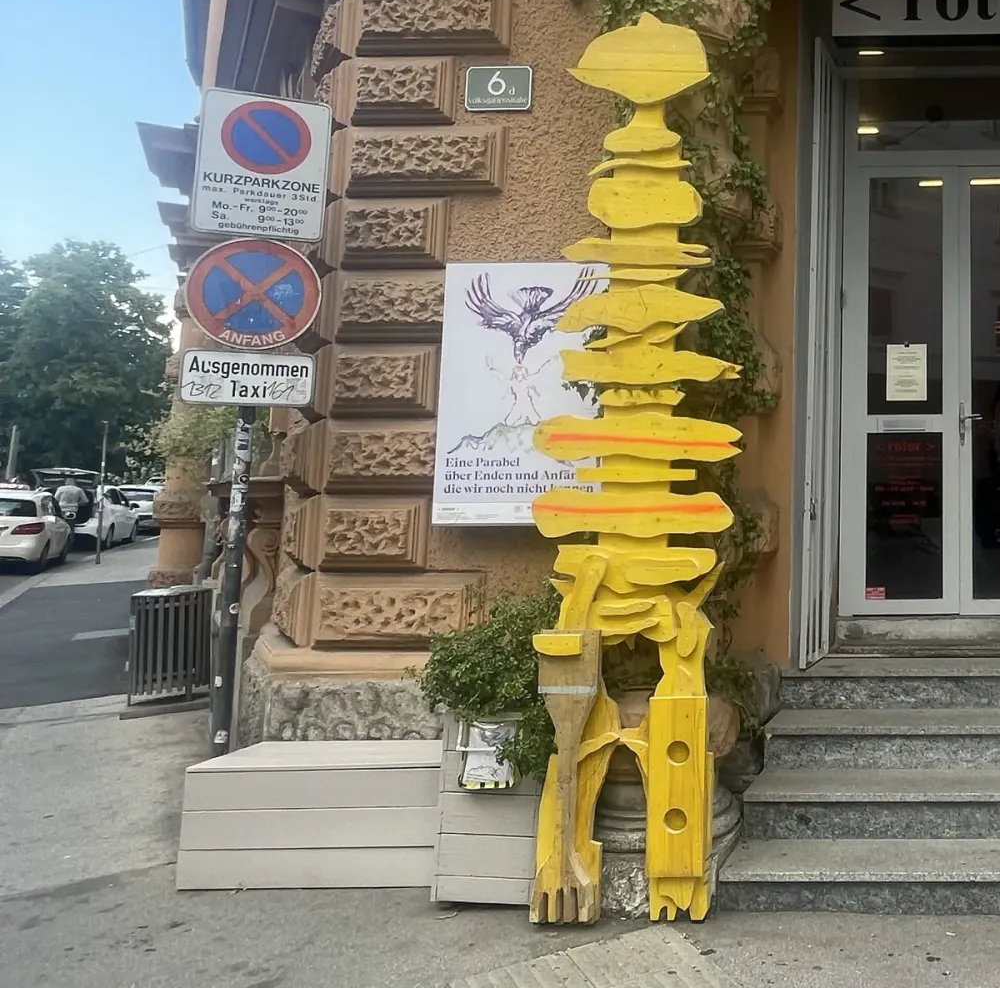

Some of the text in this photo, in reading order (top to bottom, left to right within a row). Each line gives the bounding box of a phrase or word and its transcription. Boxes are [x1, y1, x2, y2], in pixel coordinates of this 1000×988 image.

[203, 172, 320, 193] KURZPARKZONE
[202, 185, 227, 193] max.
[233, 187, 287, 200] Parkdauer
[211, 210, 230, 220] Sa.
[218, 221, 300, 236] gebührenpflichtig
[218, 330, 286, 346] ANFANG
[188, 355, 309, 379] Ausgenommen
[230, 380, 267, 399] Taxi
[445, 457, 520, 467] Eine Parabel
[444, 470, 472, 481] über
[474, 470, 513, 481] Enden
[515, 470, 539, 480] und
[443, 483, 462, 494] die
[464, 483, 483, 494] wir
[485, 483, 514, 494] noch
[516, 482, 547, 493] nicht
